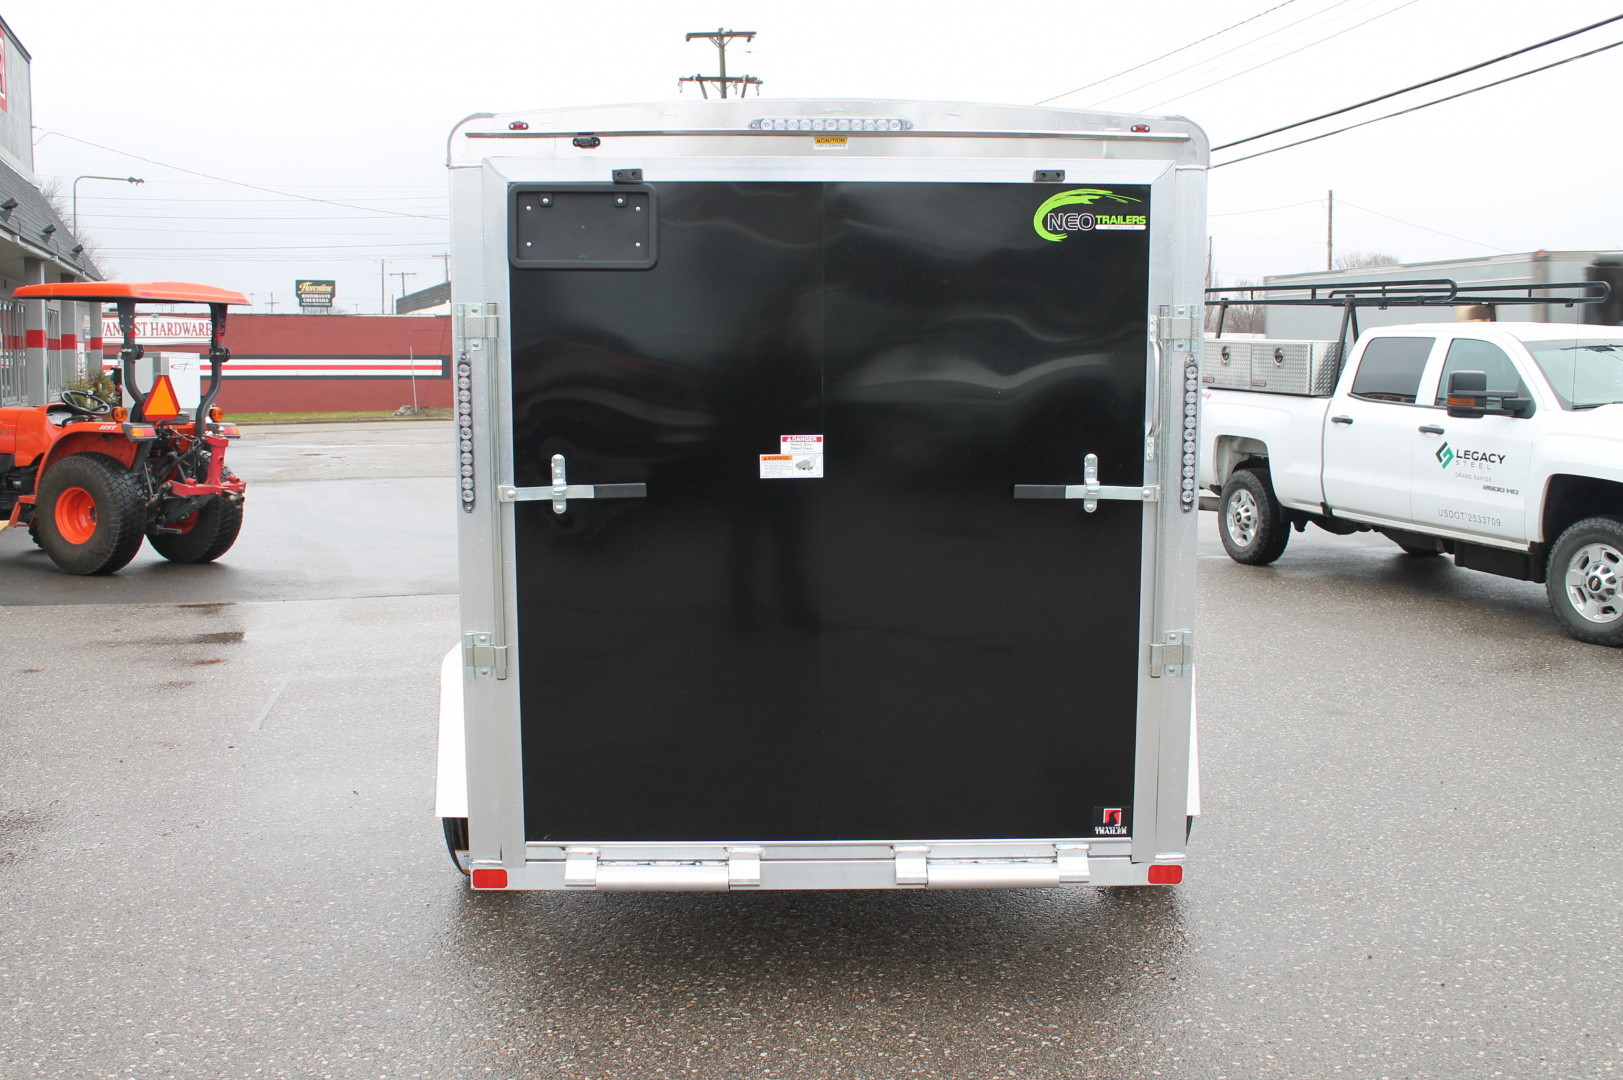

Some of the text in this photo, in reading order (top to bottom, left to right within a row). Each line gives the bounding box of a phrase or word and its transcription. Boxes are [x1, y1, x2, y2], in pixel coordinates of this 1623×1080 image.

[1047, 213, 1146, 231] NEO TRAILERS
[150, 322, 212, 336] HARDWARE
[1456, 449, 1506, 465] LEGACY
[1455, 459, 1492, 471] STEEL
[1455, 472, 1492, 483] GRAND RAPIDS
[1482, 485, 1519, 496] 2500 HD
[1437, 508, 1502, 527] USDOT 2533709
